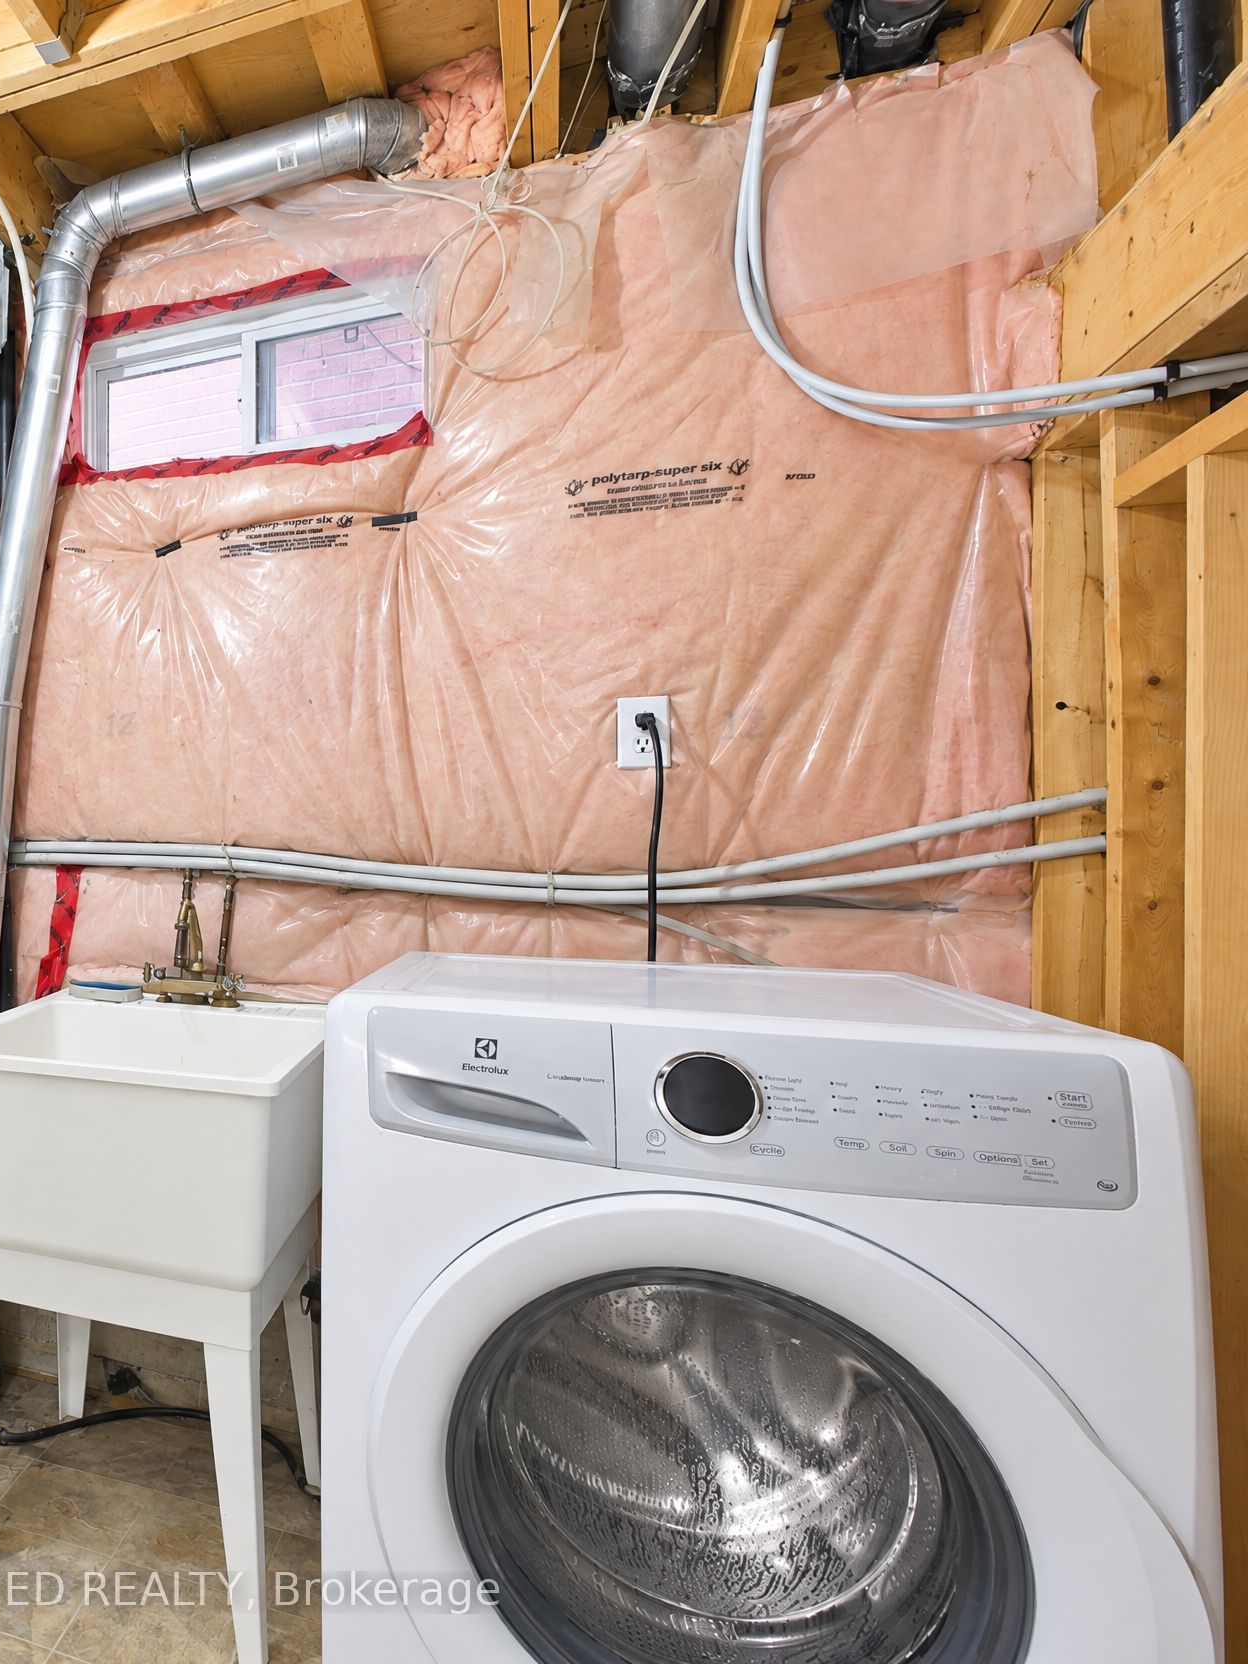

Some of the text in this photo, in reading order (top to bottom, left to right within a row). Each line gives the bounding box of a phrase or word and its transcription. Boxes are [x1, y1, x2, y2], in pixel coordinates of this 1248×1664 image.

[592, 464, 698, 487] polytarp-super
[700, 460, 722, 472] six
[462, 1063, 509, 1075] Electrolux
[1060, 1092, 1087, 1103] Start
[889, 1143, 907, 1153] Soil
[934, 1148, 956, 1159] Spin
[979, 1153, 1018, 1165] Options
[1031, 1157, 1049, 1167] Set
